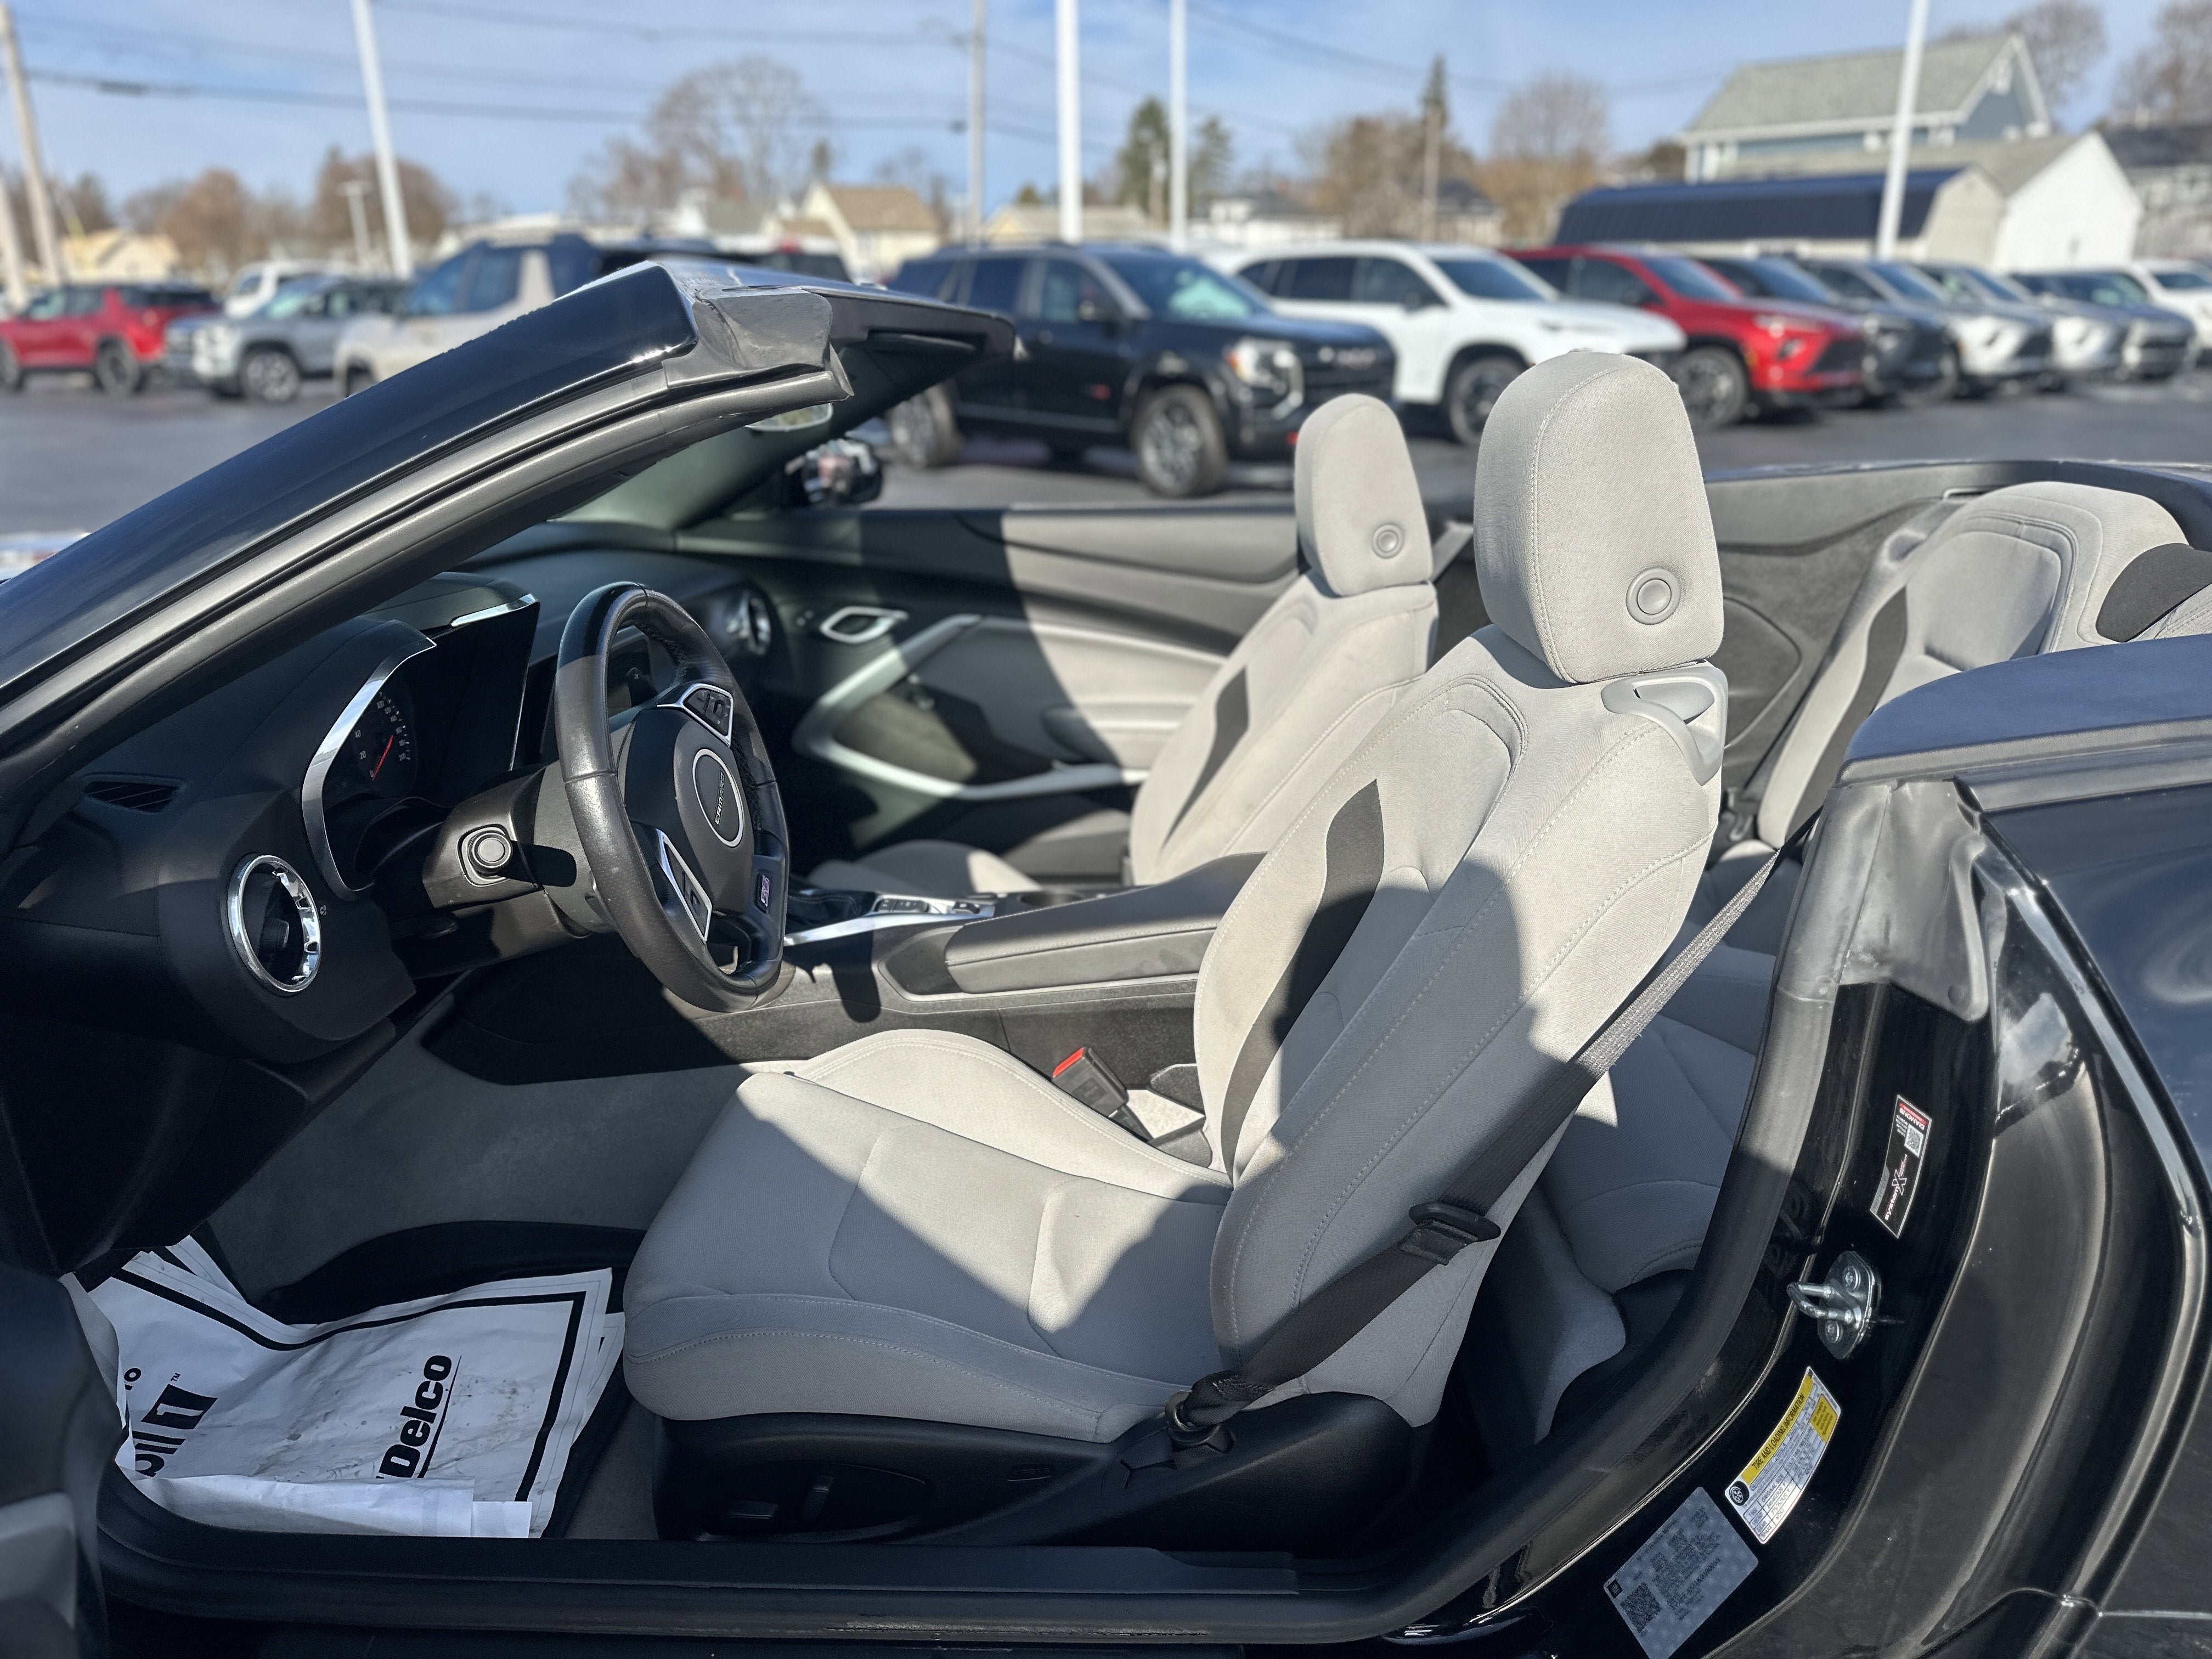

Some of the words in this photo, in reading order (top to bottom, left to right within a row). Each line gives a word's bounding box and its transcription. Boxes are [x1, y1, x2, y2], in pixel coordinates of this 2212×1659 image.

[355, 730, 362, 739] 40
[359, 750, 366, 760] 20
[714, 770, 725, 826] CAMARO
[376, 1355, 452, 1479] Delco
[1752, 1455, 1764, 1470] TIRE
[1762, 1446, 1771, 1461] AND
[1770, 1425, 1785, 1451] LOADING
[1782, 1392, 1805, 1430] INFORMATION
[1760, 1525, 1773, 1538] SPARE
[1775, 1508, 1785, 1520] NONE
